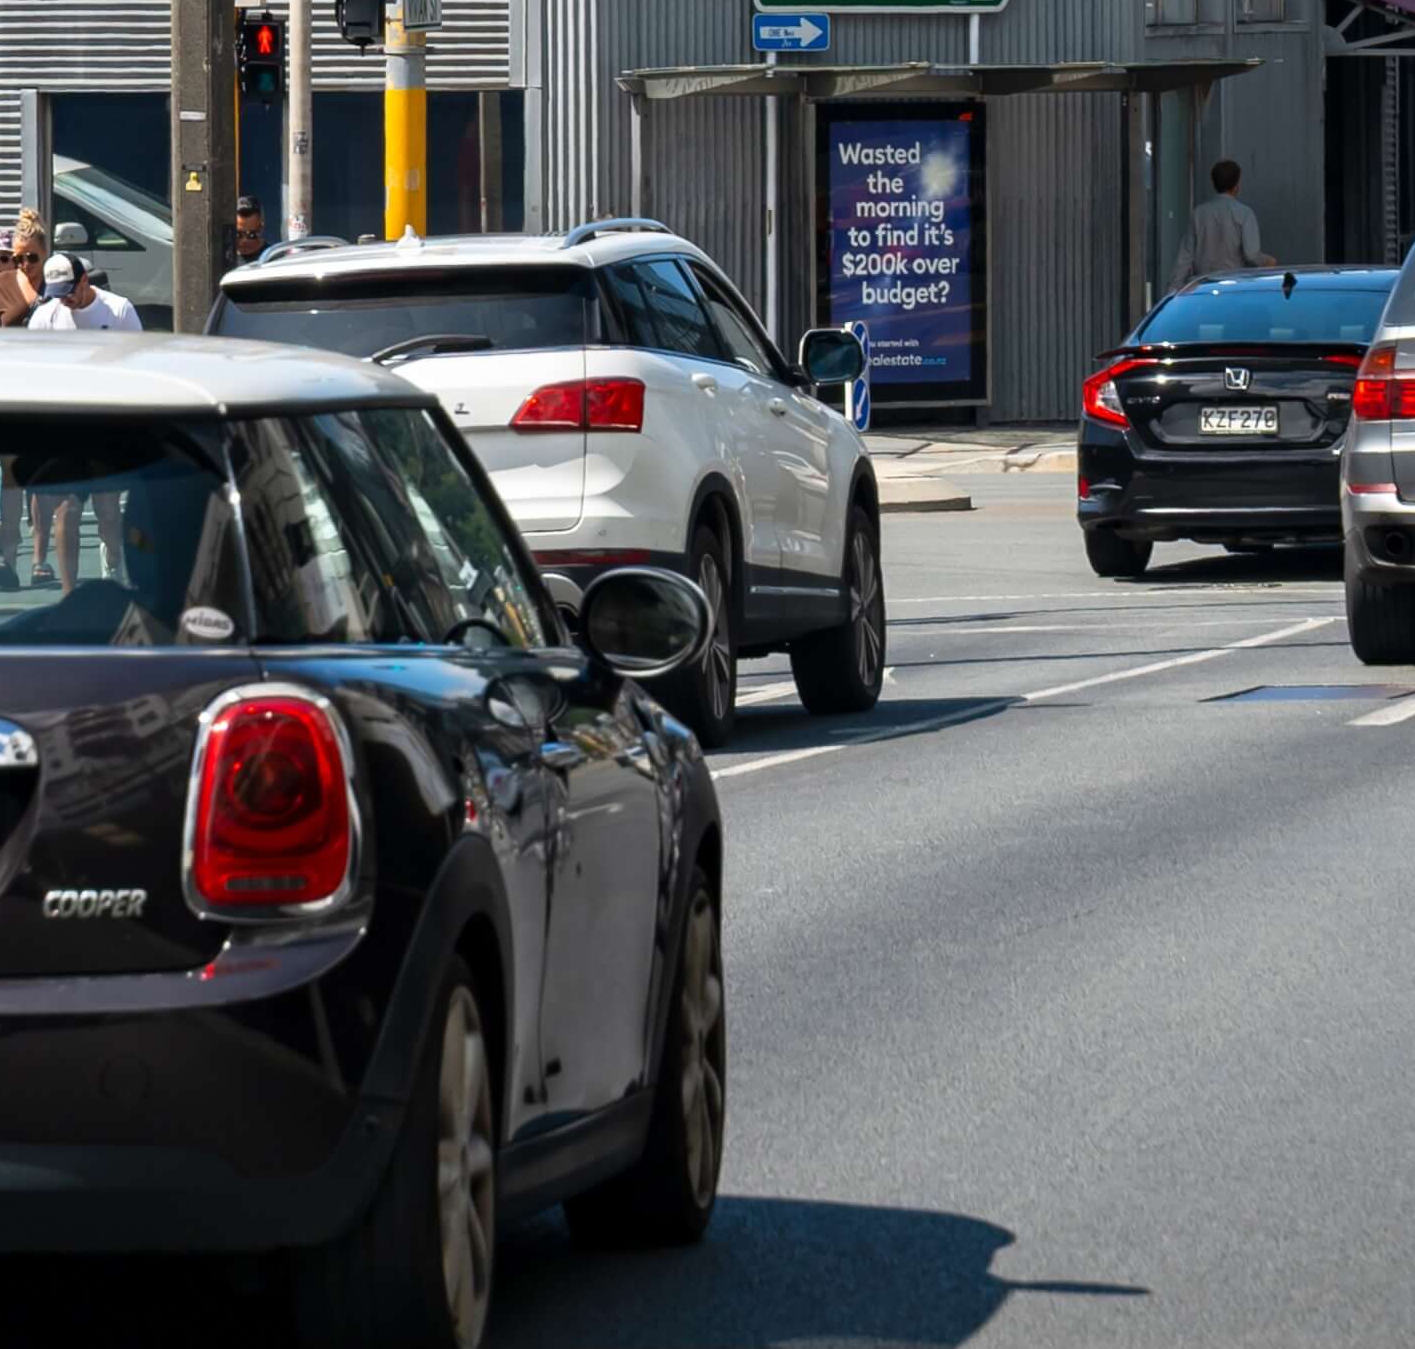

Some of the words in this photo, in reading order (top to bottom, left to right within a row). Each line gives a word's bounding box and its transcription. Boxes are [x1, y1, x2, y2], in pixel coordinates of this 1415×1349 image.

[839, 141, 921, 165] Wasted
[867, 170, 904, 194] the
[856, 195, 944, 222] morning
[848, 227, 870, 247] to
[875, 224, 918, 246] find
[924, 224, 954, 245] it's
[842, 252, 908, 278] $200k
[913, 257, 959, 274] over
[862, 281, 950, 310] budget?
[43, 889, 146, 918] COOPER
